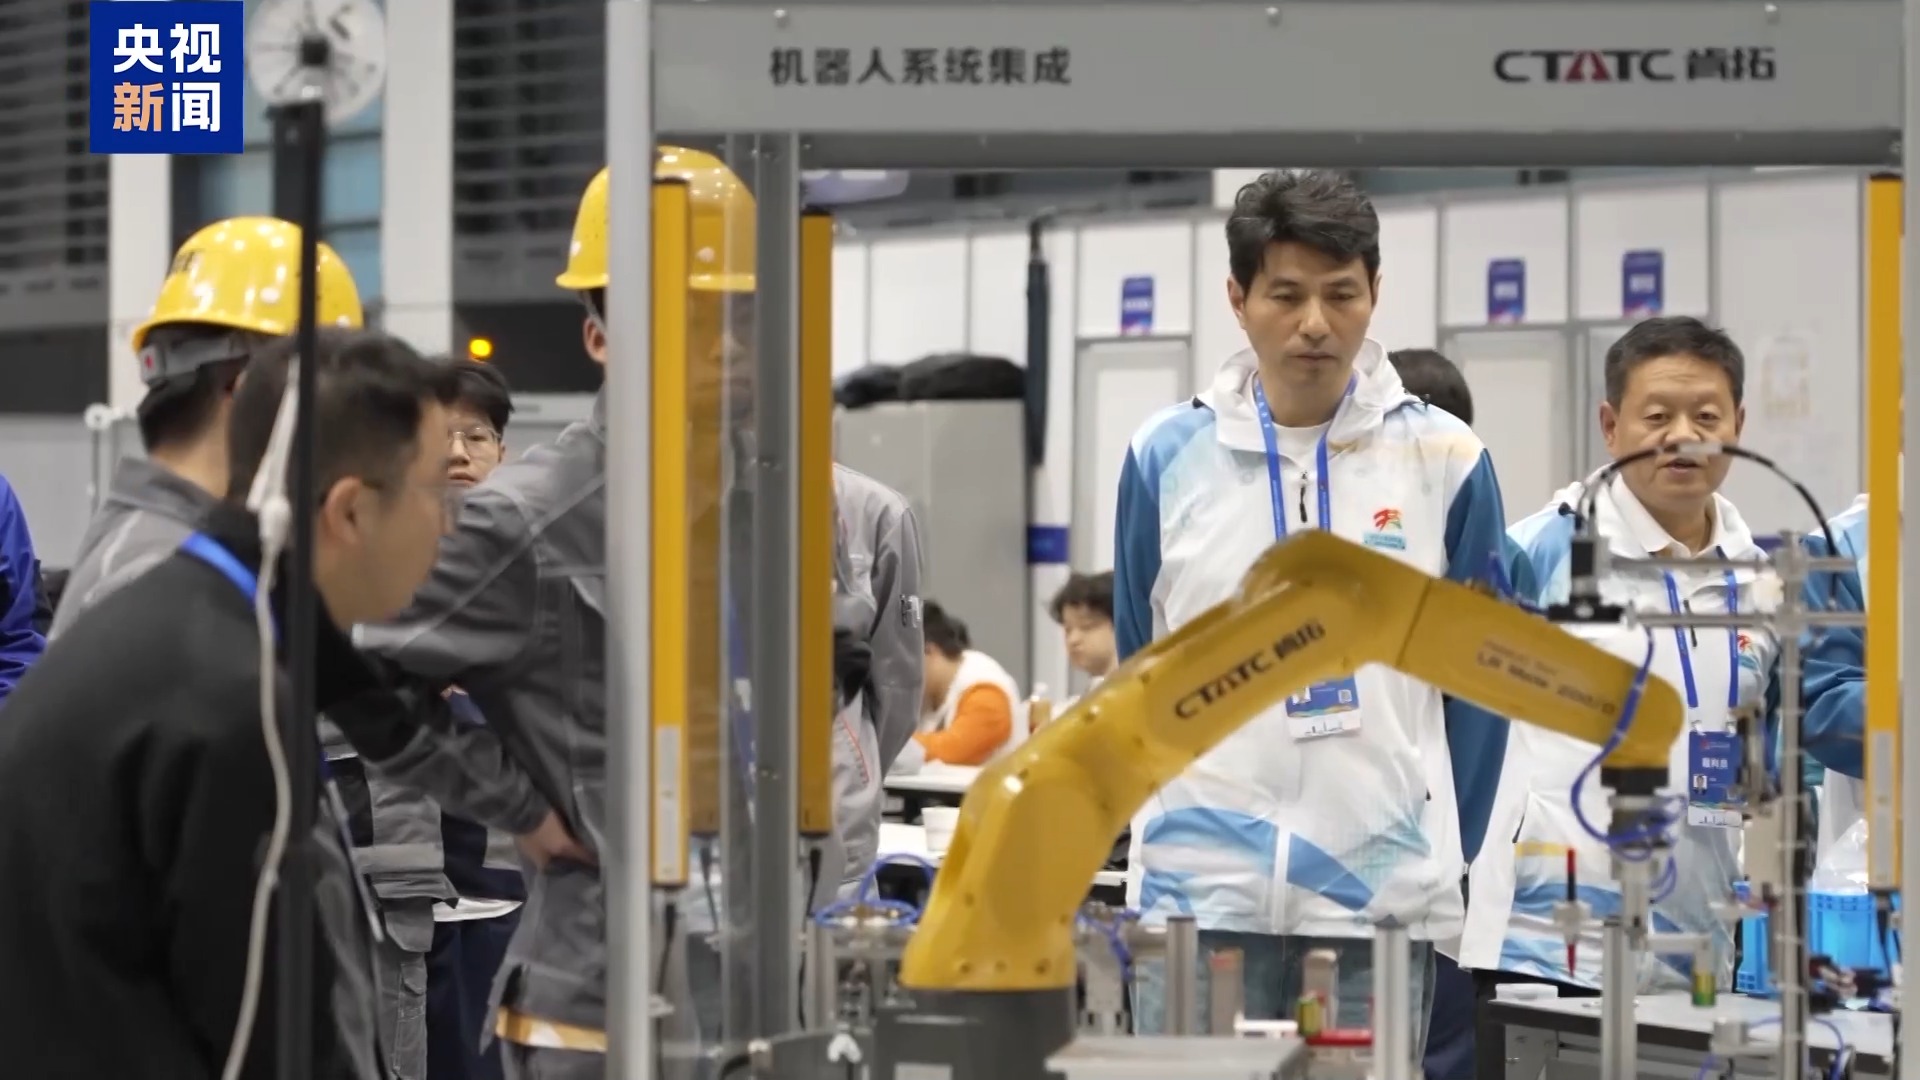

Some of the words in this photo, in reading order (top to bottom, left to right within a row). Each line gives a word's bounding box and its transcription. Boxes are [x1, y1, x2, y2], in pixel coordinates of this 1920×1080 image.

[769, 46, 1072, 86] 机器人系统集成
[1494, 48, 1675, 82] CTATC
